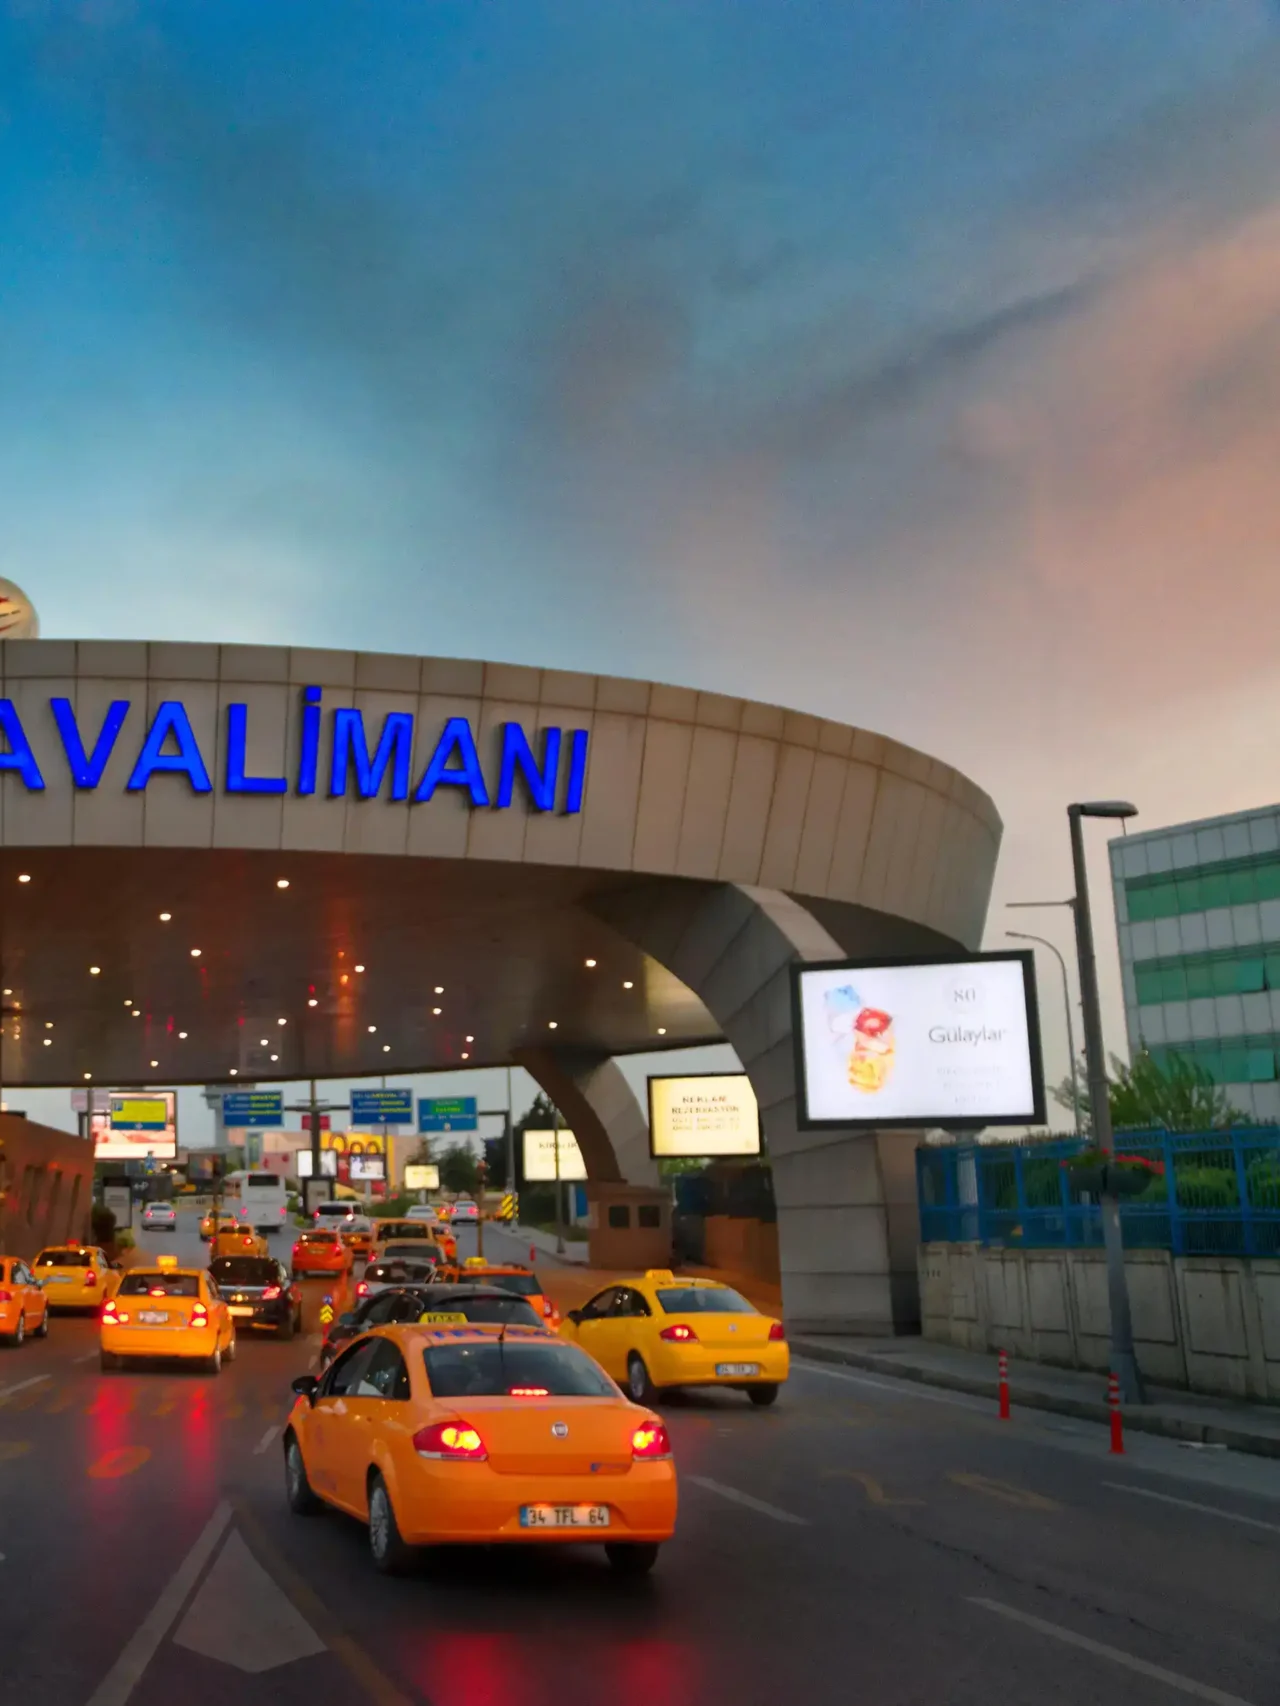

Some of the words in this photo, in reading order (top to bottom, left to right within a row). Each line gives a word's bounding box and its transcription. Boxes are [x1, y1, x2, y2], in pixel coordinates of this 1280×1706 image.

[529, 1508, 546, 1524] 34
[554, 1508, 579, 1524] TFL
[588, 1508, 605, 1524] 64
